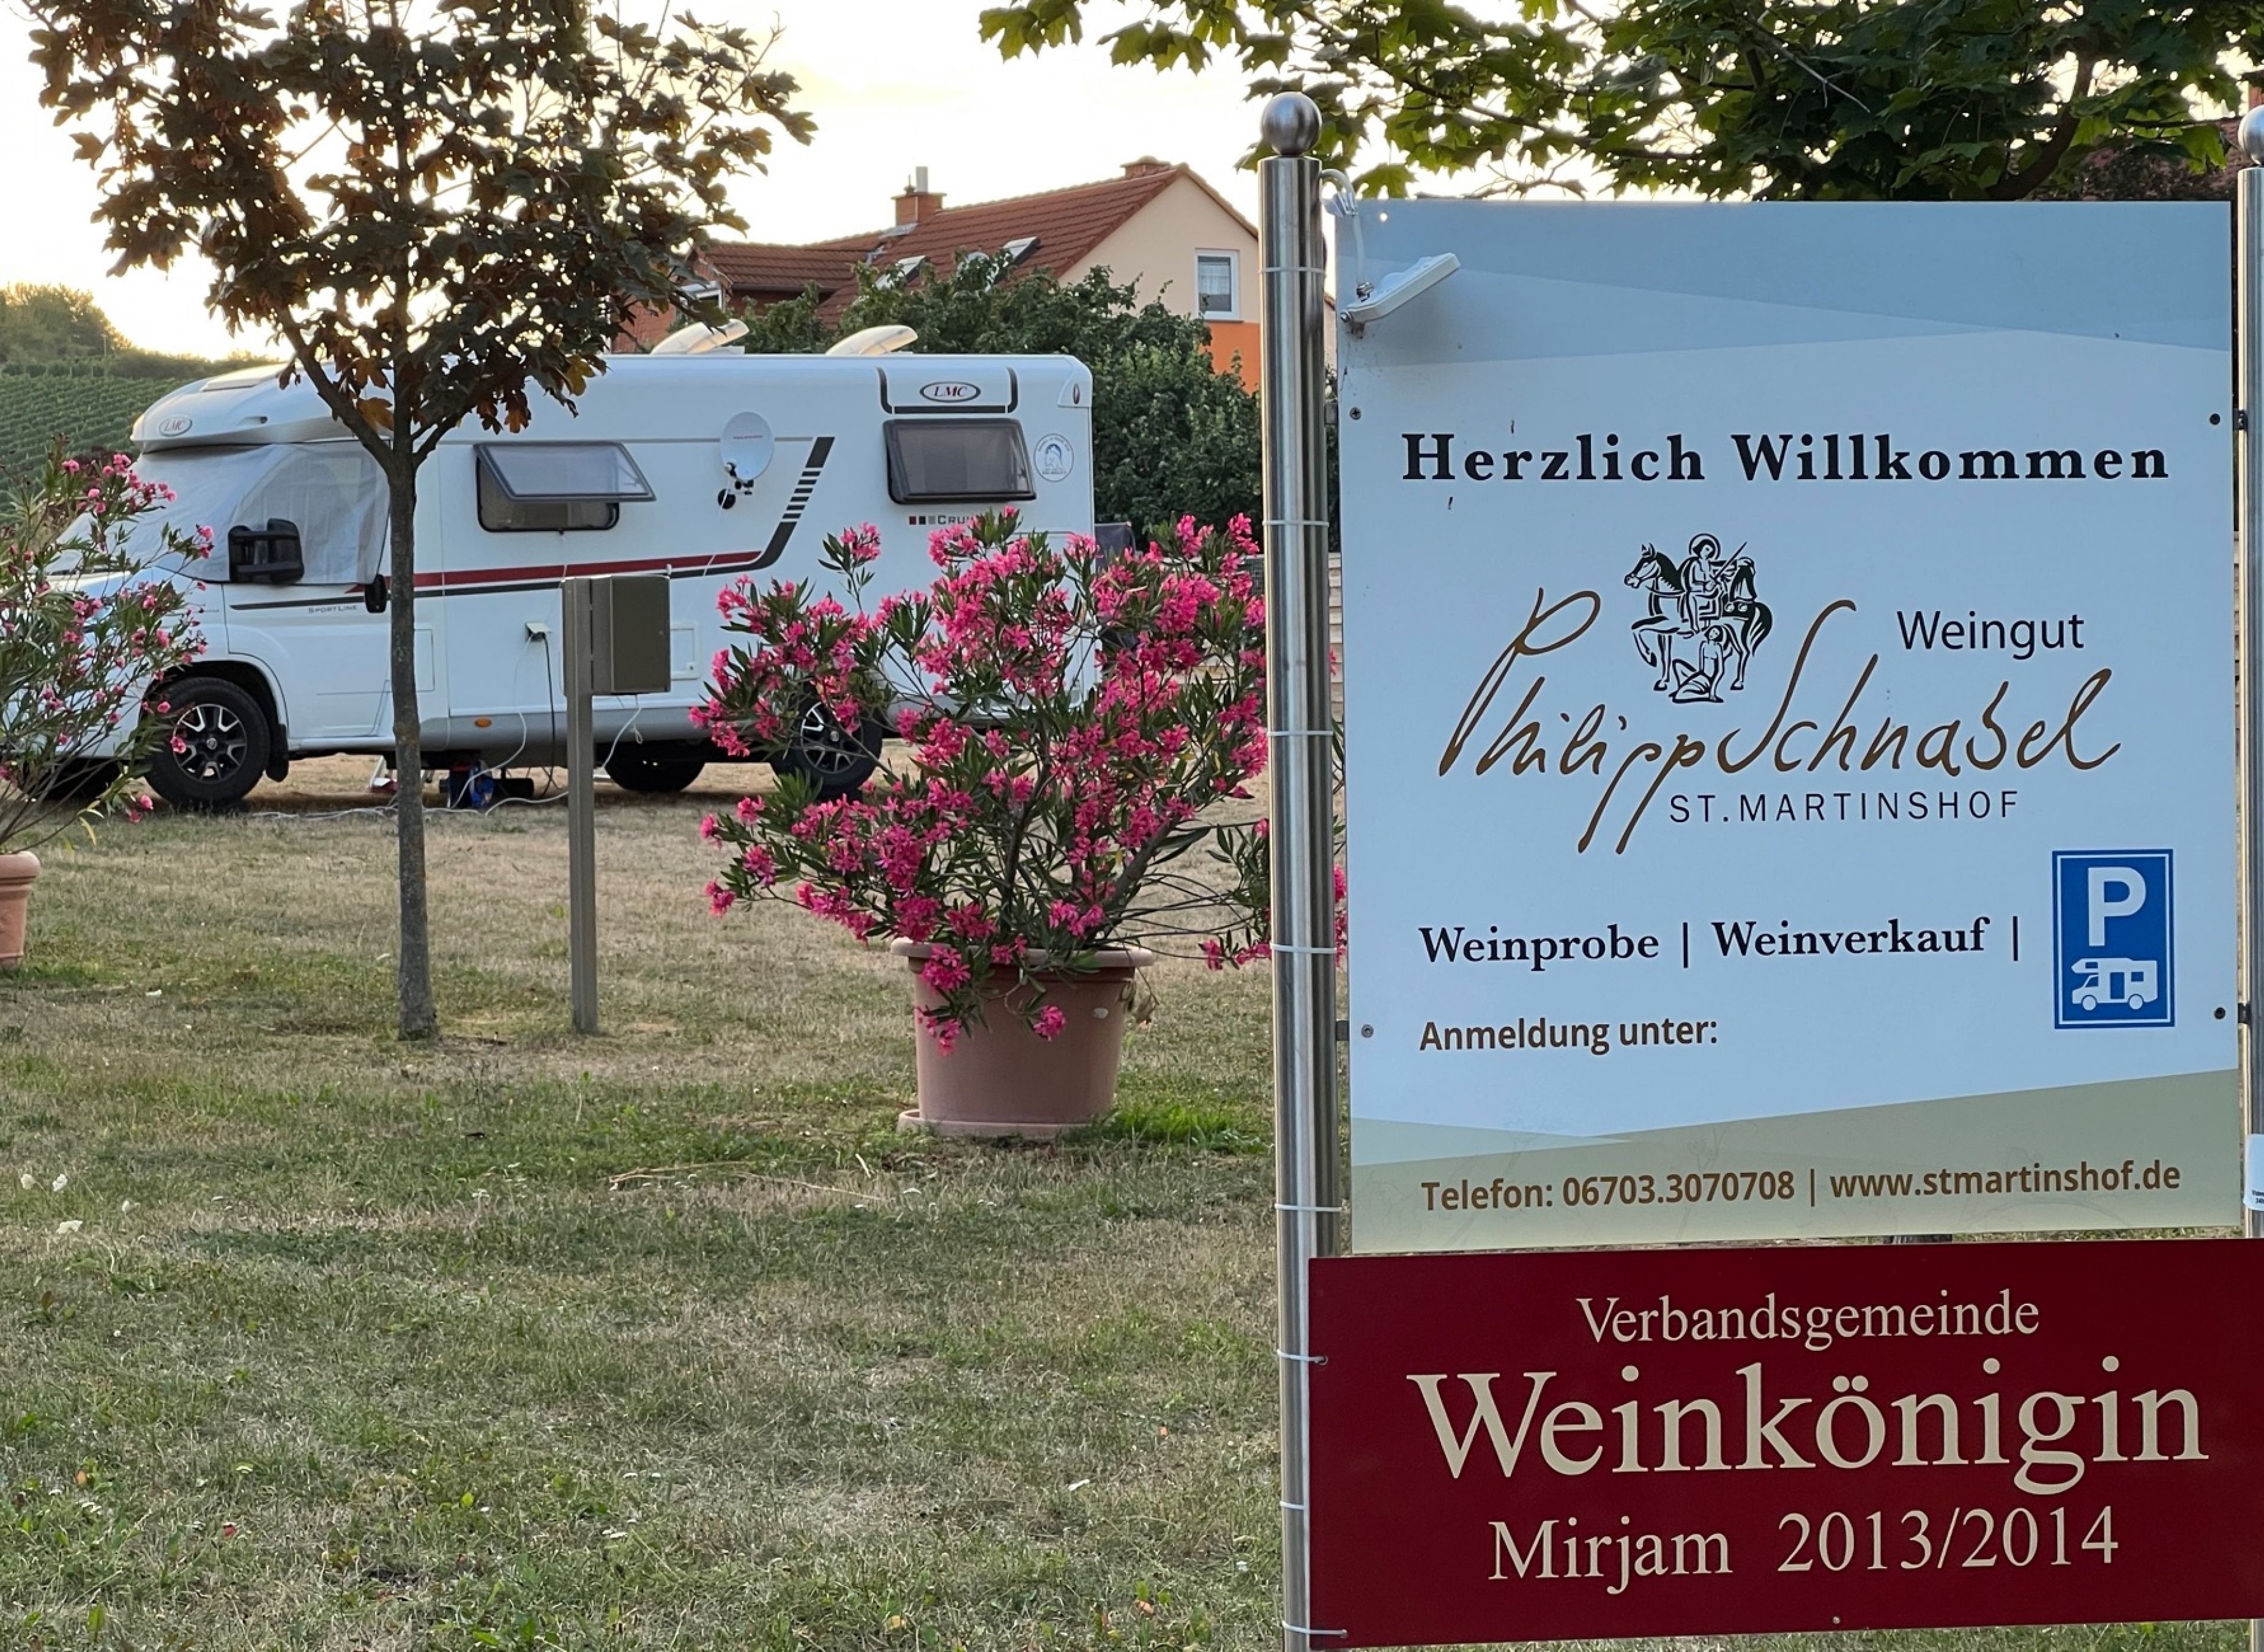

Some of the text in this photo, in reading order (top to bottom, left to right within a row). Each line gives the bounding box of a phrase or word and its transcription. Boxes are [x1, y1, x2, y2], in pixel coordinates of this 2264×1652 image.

[934, 385, 968, 397] LMC
[1401, 433, 2169, 481] Herzlich Willkommen
[1896, 610, 2085, 660] Weingut
[1439, 587, 2122, 855] Philipp Schnabel
[1669, 791, 2017, 823] ST.MARTINSHOF
[2087, 866, 2147, 947] P
[1418, 923, 1659, 972] Weinprobe
[1711, 917, 1991, 956] Weinverkauf
[1419, 1017, 1717, 1055] Anmeldung unter:
[1420, 1177, 1554, 1211] Telefon:
[1562, 1170, 1795, 1207] 06703.3070708
[1829, 1159, 2181, 1198] www.stmartinshof.de
[1576, 1288, 2039, 1352] Verbandsgemeinde
[1406, 1355, 2209, 1495] Weinkönigin
[1488, 1505, 2119, 1594] Mirjam 2013/2014
